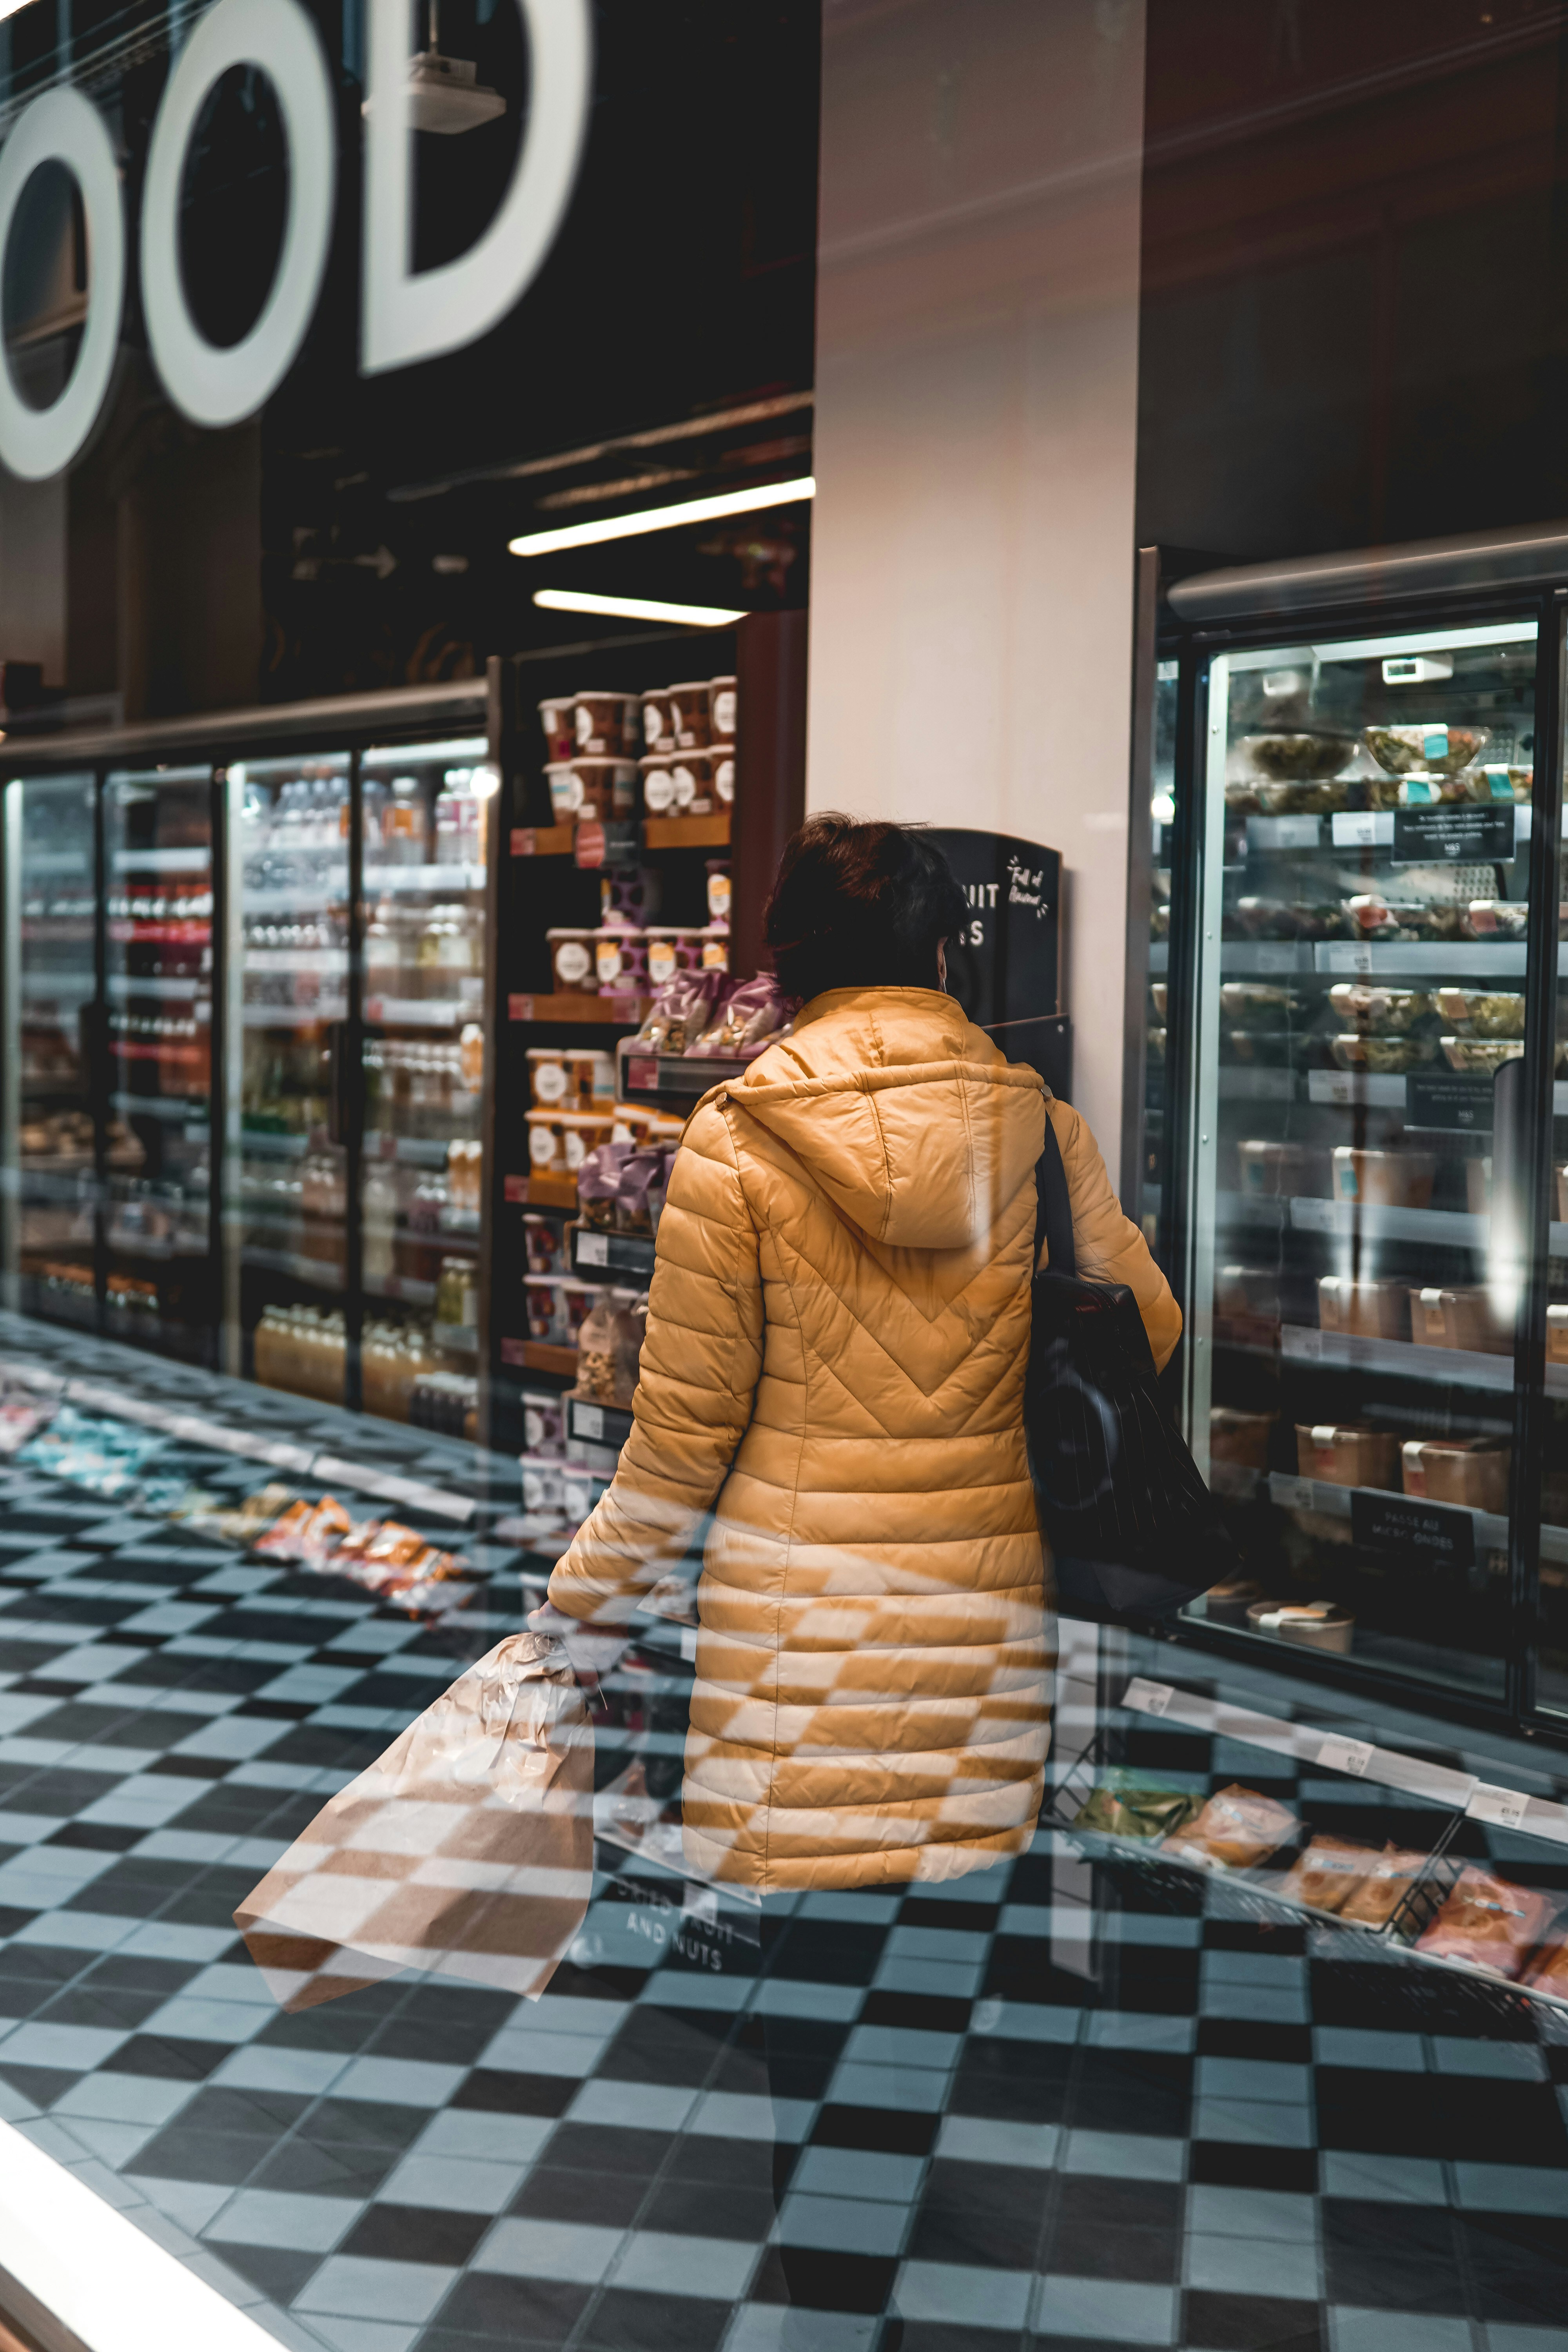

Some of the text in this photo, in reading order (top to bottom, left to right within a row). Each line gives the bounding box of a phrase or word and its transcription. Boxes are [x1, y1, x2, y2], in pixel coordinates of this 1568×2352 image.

[0, 0, 592, 480] OOD
[962, 884, 999, 909] UIT
[1422, 1518, 1439, 1532] AU
[627, 1911, 722, 1971] AND NUTS
